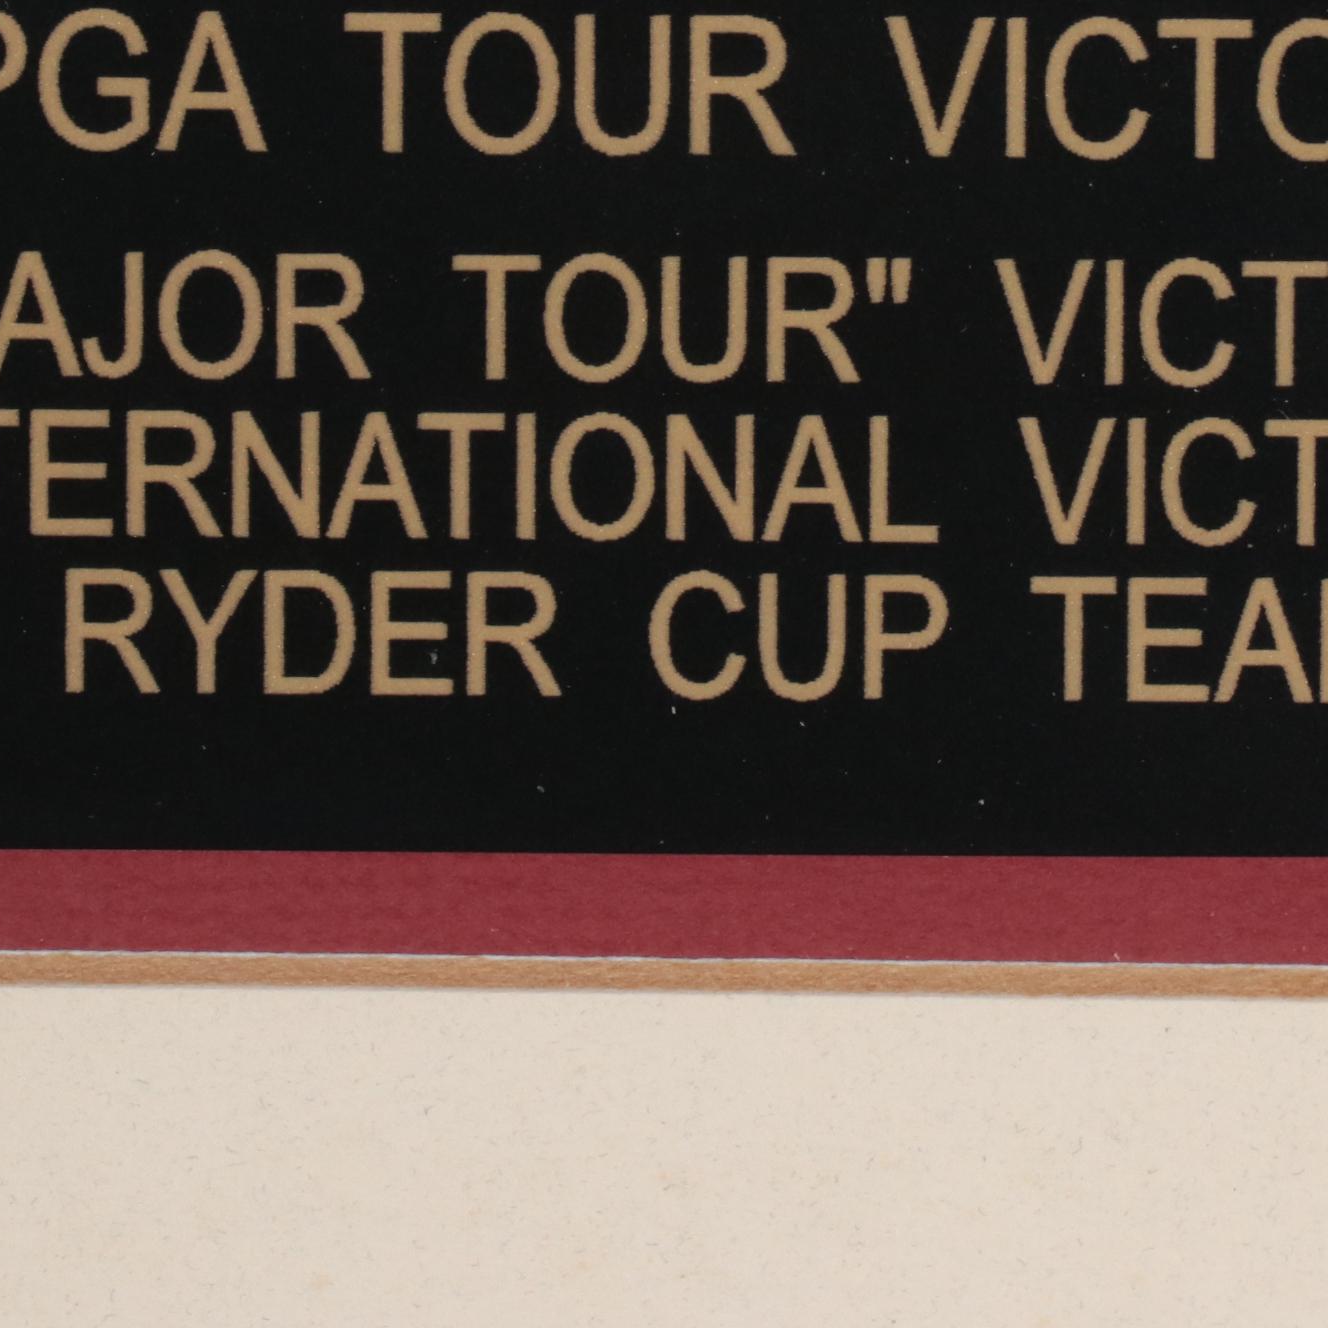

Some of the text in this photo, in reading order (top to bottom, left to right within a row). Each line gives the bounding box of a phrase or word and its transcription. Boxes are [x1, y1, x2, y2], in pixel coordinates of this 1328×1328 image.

[343, 10, 798, 158] TOUR
[451, 251, 913, 384] TOUR"
[64, 566, 563, 698] RYDER
[647, 568, 950, 703] CUP
